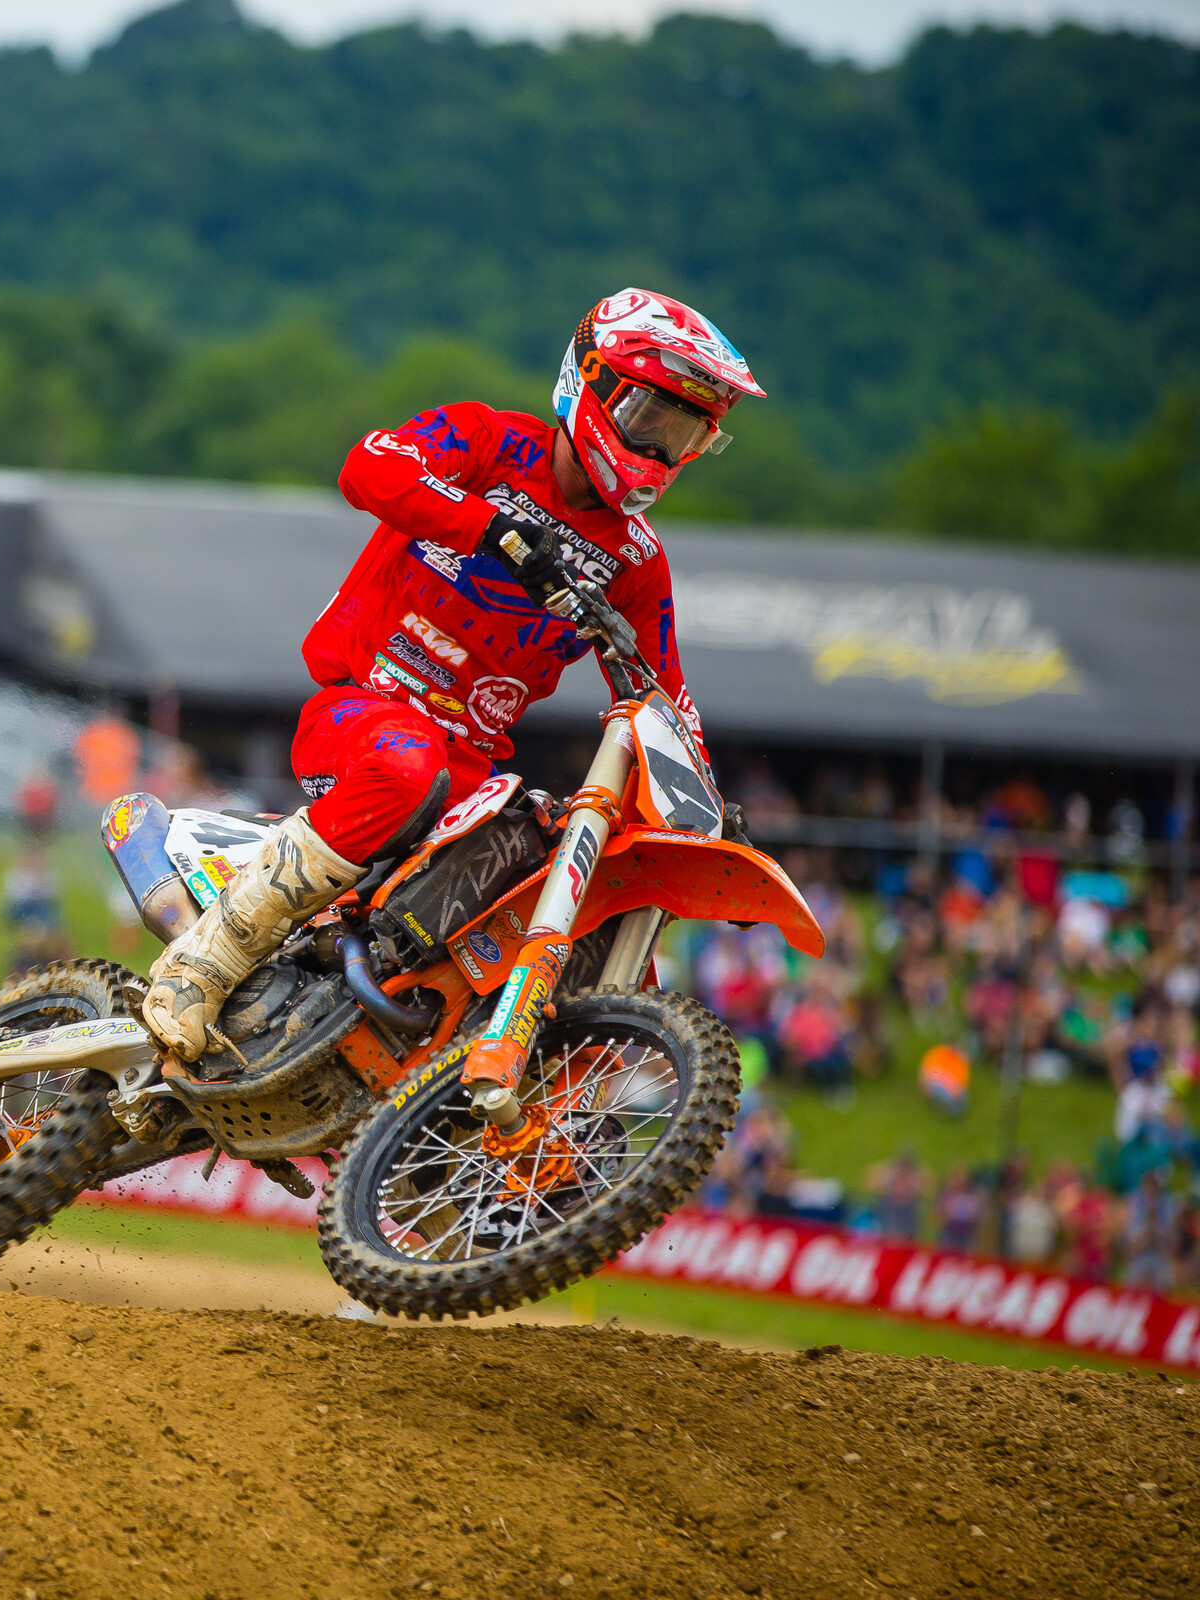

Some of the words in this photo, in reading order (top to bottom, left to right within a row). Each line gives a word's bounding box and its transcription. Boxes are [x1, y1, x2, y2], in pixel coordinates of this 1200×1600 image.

[498, 425, 546, 470] FLY
[585, 415, 618, 466] FLYRACING
[512, 491, 557, 527] ROCKY
[554, 523, 620, 572] MOUNTAIN
[400, 611, 469, 668] KTM
[385, 662, 427, 694] MOTOREX
[173, 852, 194, 874] KTM
[496, 864, 551, 903] POWERPARTS
[403, 911, 426, 938] Engine
[423, 932, 435, 948] Ice
[488, 984, 520, 1036] MOTOREX
